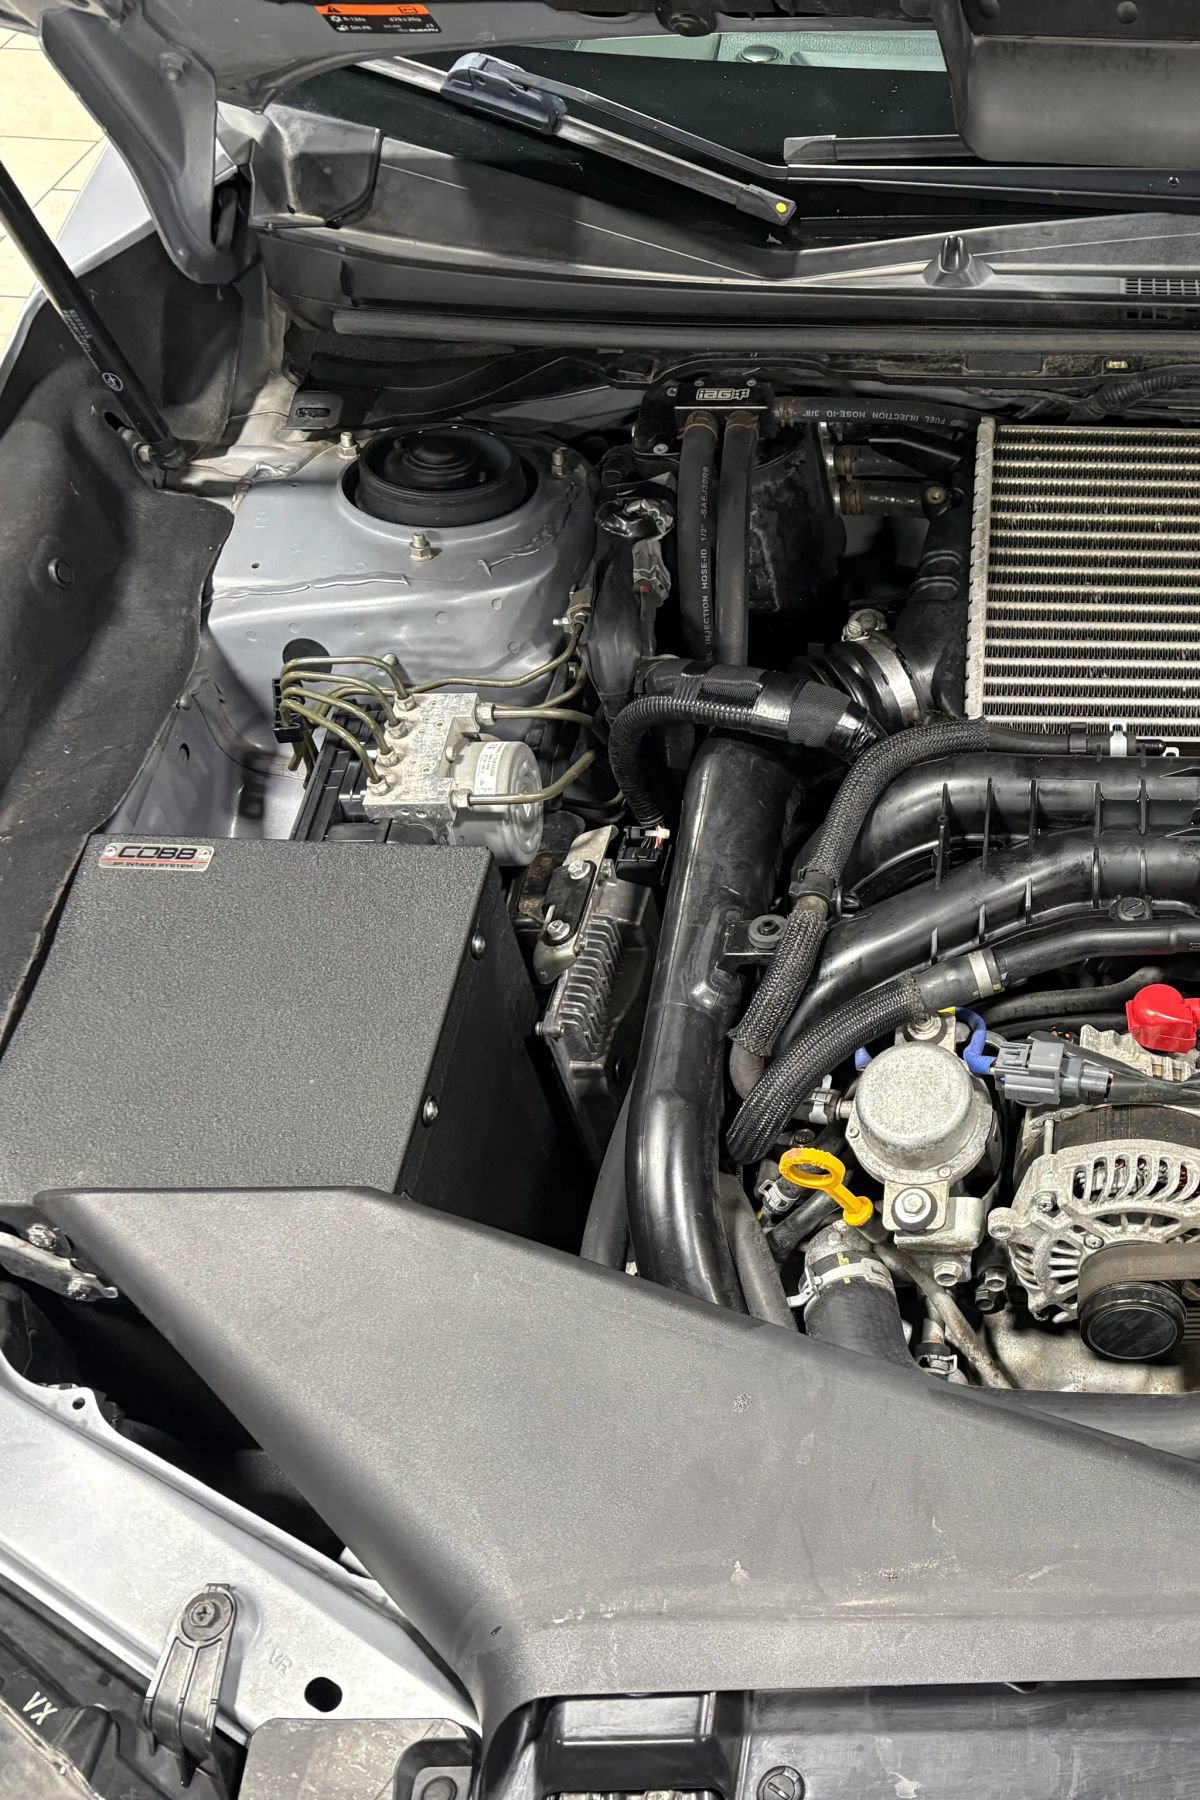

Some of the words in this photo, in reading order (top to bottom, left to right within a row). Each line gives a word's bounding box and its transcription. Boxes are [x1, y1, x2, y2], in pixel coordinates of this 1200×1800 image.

[826, 410, 866, 418] HOSE-ID
[871, 411, 919, 422] INJECTION
[924, 415, 946, 425] FUEL
[700, 548, 709, 590] HOSE-ID
[702, 595, 712, 645] INJECTION
[117, 845, 198, 860] COBB
[22, 1691, 59, 1726] VX
